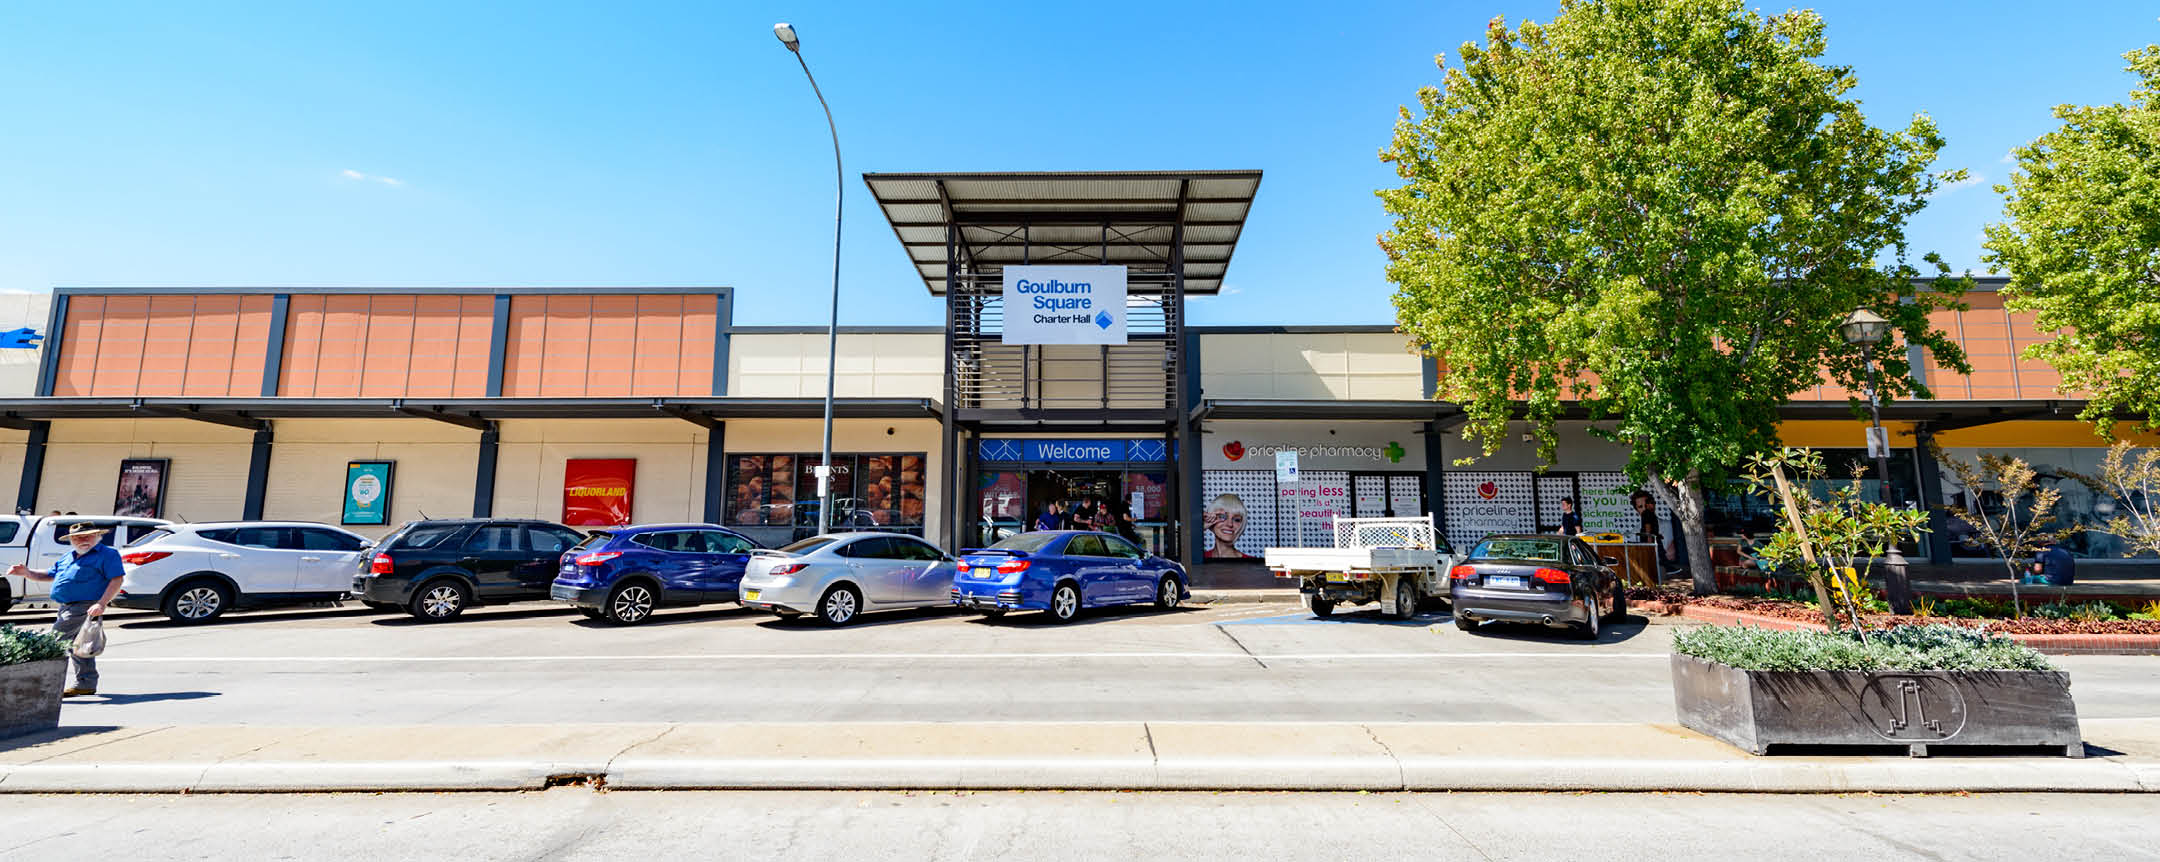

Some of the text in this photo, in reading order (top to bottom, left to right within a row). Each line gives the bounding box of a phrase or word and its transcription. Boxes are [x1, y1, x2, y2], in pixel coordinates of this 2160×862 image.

[1016, 279, 1092, 294] Goulburn
[1033, 295, 1092, 312] Square
[1033, 314, 1091, 324] Charter Hall
[1038, 442, 1111, 459] Welcome
[1310, 444, 1381, 461] pharmacy
[569, 487, 627, 497] LIQUORLAND
[1319, 485, 1344, 497] less
[1582, 488, 1603, 496] here
[1462, 505, 1517, 518] priceline
[1583, 509, 1624, 518] sickness
[1463, 517, 1518, 529] pharmacy
[1584, 519, 1603, 528] and
